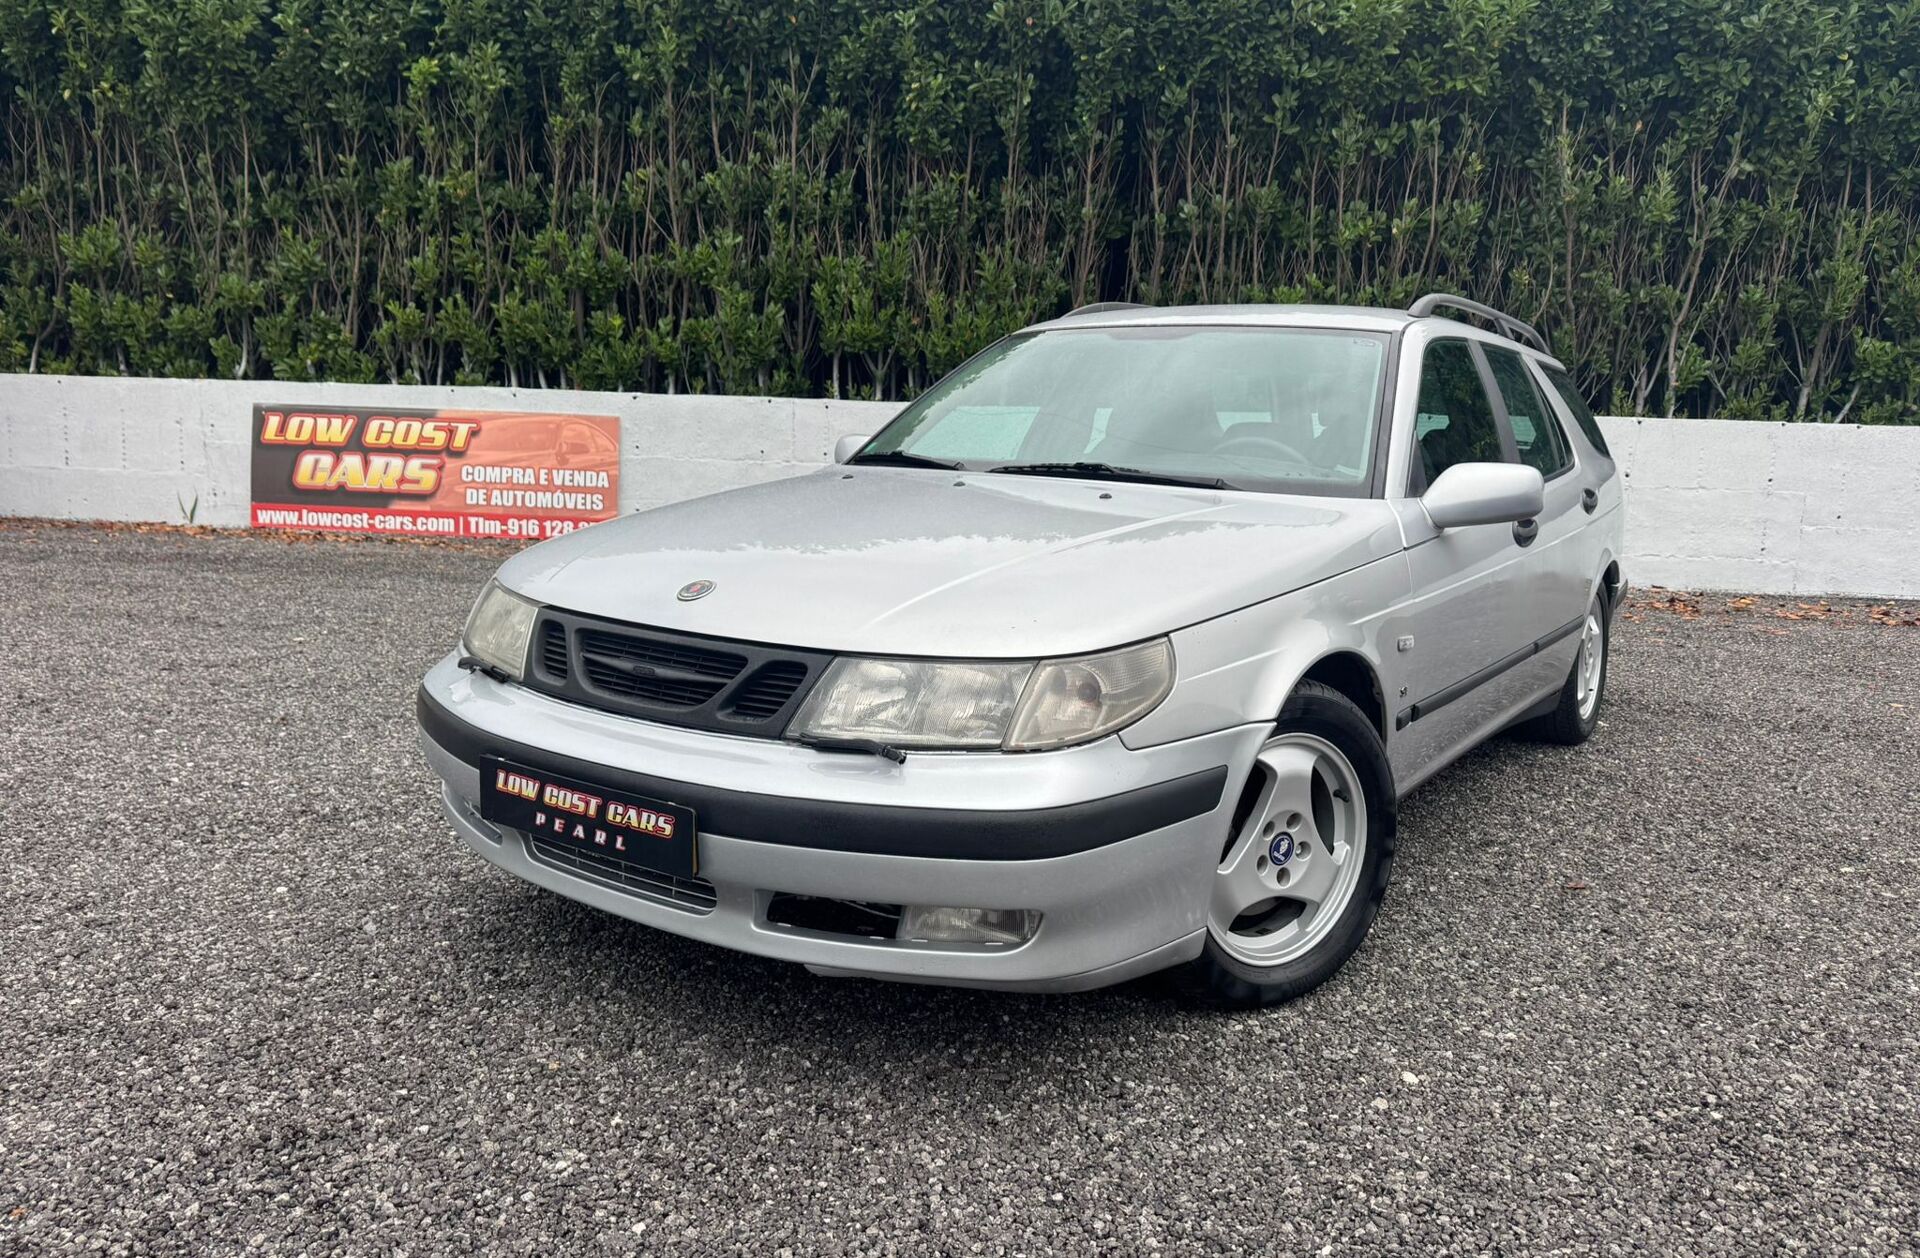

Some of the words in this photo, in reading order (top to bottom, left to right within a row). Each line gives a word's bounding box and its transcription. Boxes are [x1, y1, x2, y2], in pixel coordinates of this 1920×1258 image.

[261, 412, 357, 445] LOW
[362, 417, 480, 450] COST
[292, 450, 446, 494] CARS
[461, 465, 536, 485] COMPRA
[539, 468, 548, 485] E
[552, 469, 609, 488] VENDA
[465, 488, 487, 505] DE
[490, 489, 604, 510] AUTOMÓVEIS
[256, 509, 455, 532] www.lowcost-cars.com
[543, 521, 574, 537] 128
[496, 769, 540, 801] LOW
[543, 784, 602, 818] COST
[606, 801, 675, 838] CARS
[535, 812, 626, 850] PEARL
